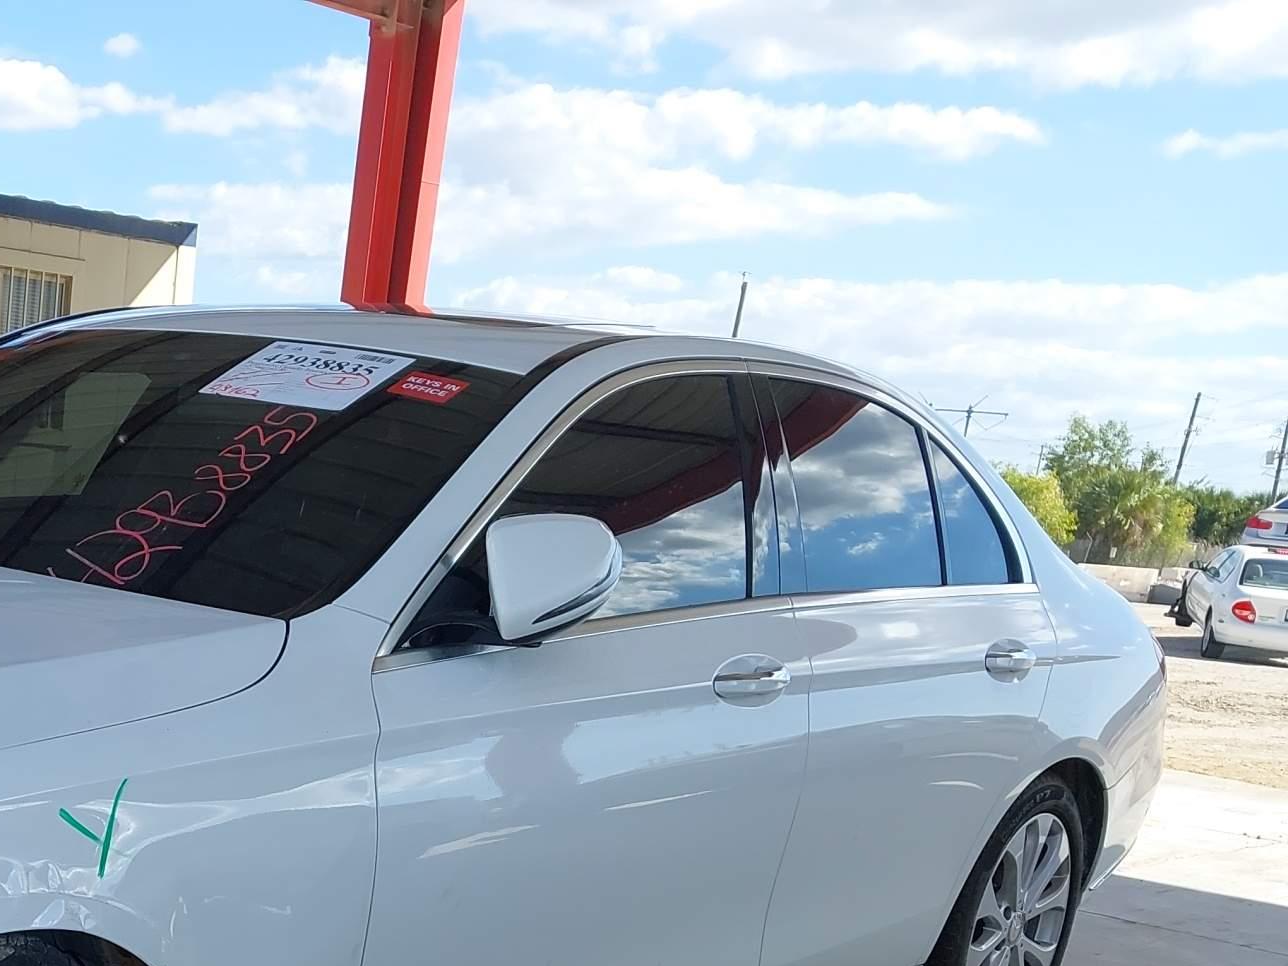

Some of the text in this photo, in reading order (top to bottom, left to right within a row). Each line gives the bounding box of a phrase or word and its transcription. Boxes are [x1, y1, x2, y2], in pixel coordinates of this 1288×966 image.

[263, 353, 380, 376] 42938835
[401, 382, 449, 397] OFFICE
[406, 375, 461, 392] KEYS IN
